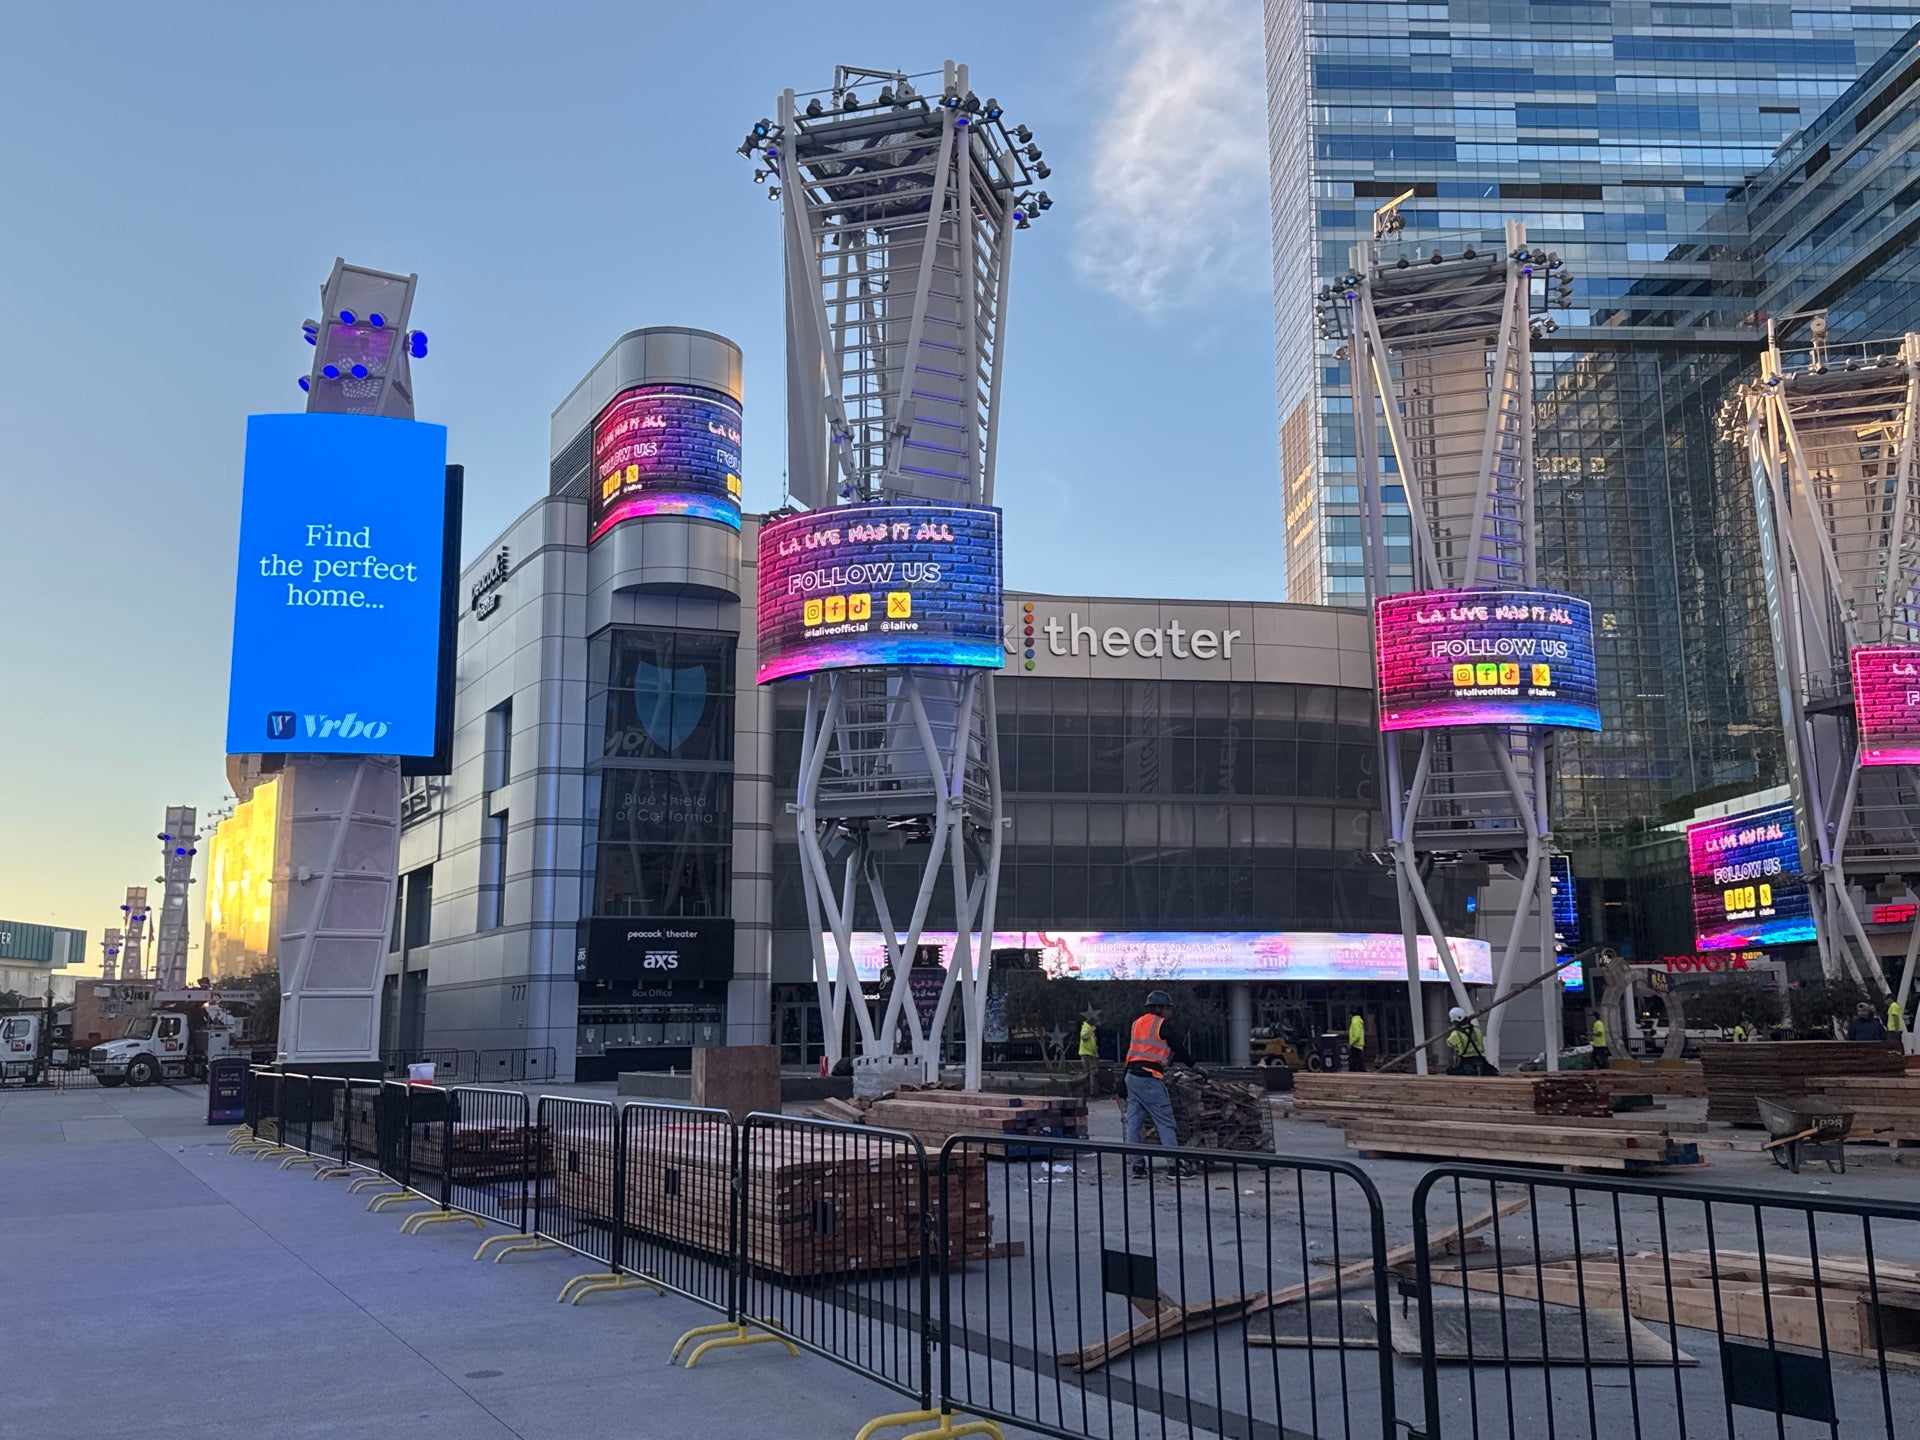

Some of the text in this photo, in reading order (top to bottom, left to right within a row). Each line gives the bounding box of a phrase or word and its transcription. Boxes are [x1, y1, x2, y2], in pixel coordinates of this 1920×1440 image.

[643, 415, 666, 428] ALL
[633, 442, 657, 458] US
[304, 523, 372, 549] Find
[805, 528, 841, 550] LIVE
[848, 523, 888, 543] HAS
[892, 522, 912, 541] IT
[915, 522, 955, 542] ALL
[259, 553, 418, 583] the perfect
[788, 562, 942, 596] FOLLOW US
[285, 583, 386, 609] home...
[1450, 606, 1490, 621] LIVE
[1531, 606, 1546, 621] IT
[804, 620, 919, 640] @laliveofficial @lalive
[1043, 612, 1242, 660] theater
[1431, 638, 1568, 659] FOLLOW US
[1454, 687, 1557, 698] @laliveofficial @lalive
[303, 712, 388, 740] Vrbo
[624, 792, 707, 808] Blue Shield
[615, 809, 714, 824] of California
[1714, 857, 1782, 884] FOLLOW US
[0, 931, 11, 945] ER
[627, 929, 699, 942] peacock theater
[643, 954, 679, 971] axs
[1663, 954, 1748, 973] TOYOTA
[511, 984, 527, 1002] 777
[632, 988, 673, 998] Box Office
